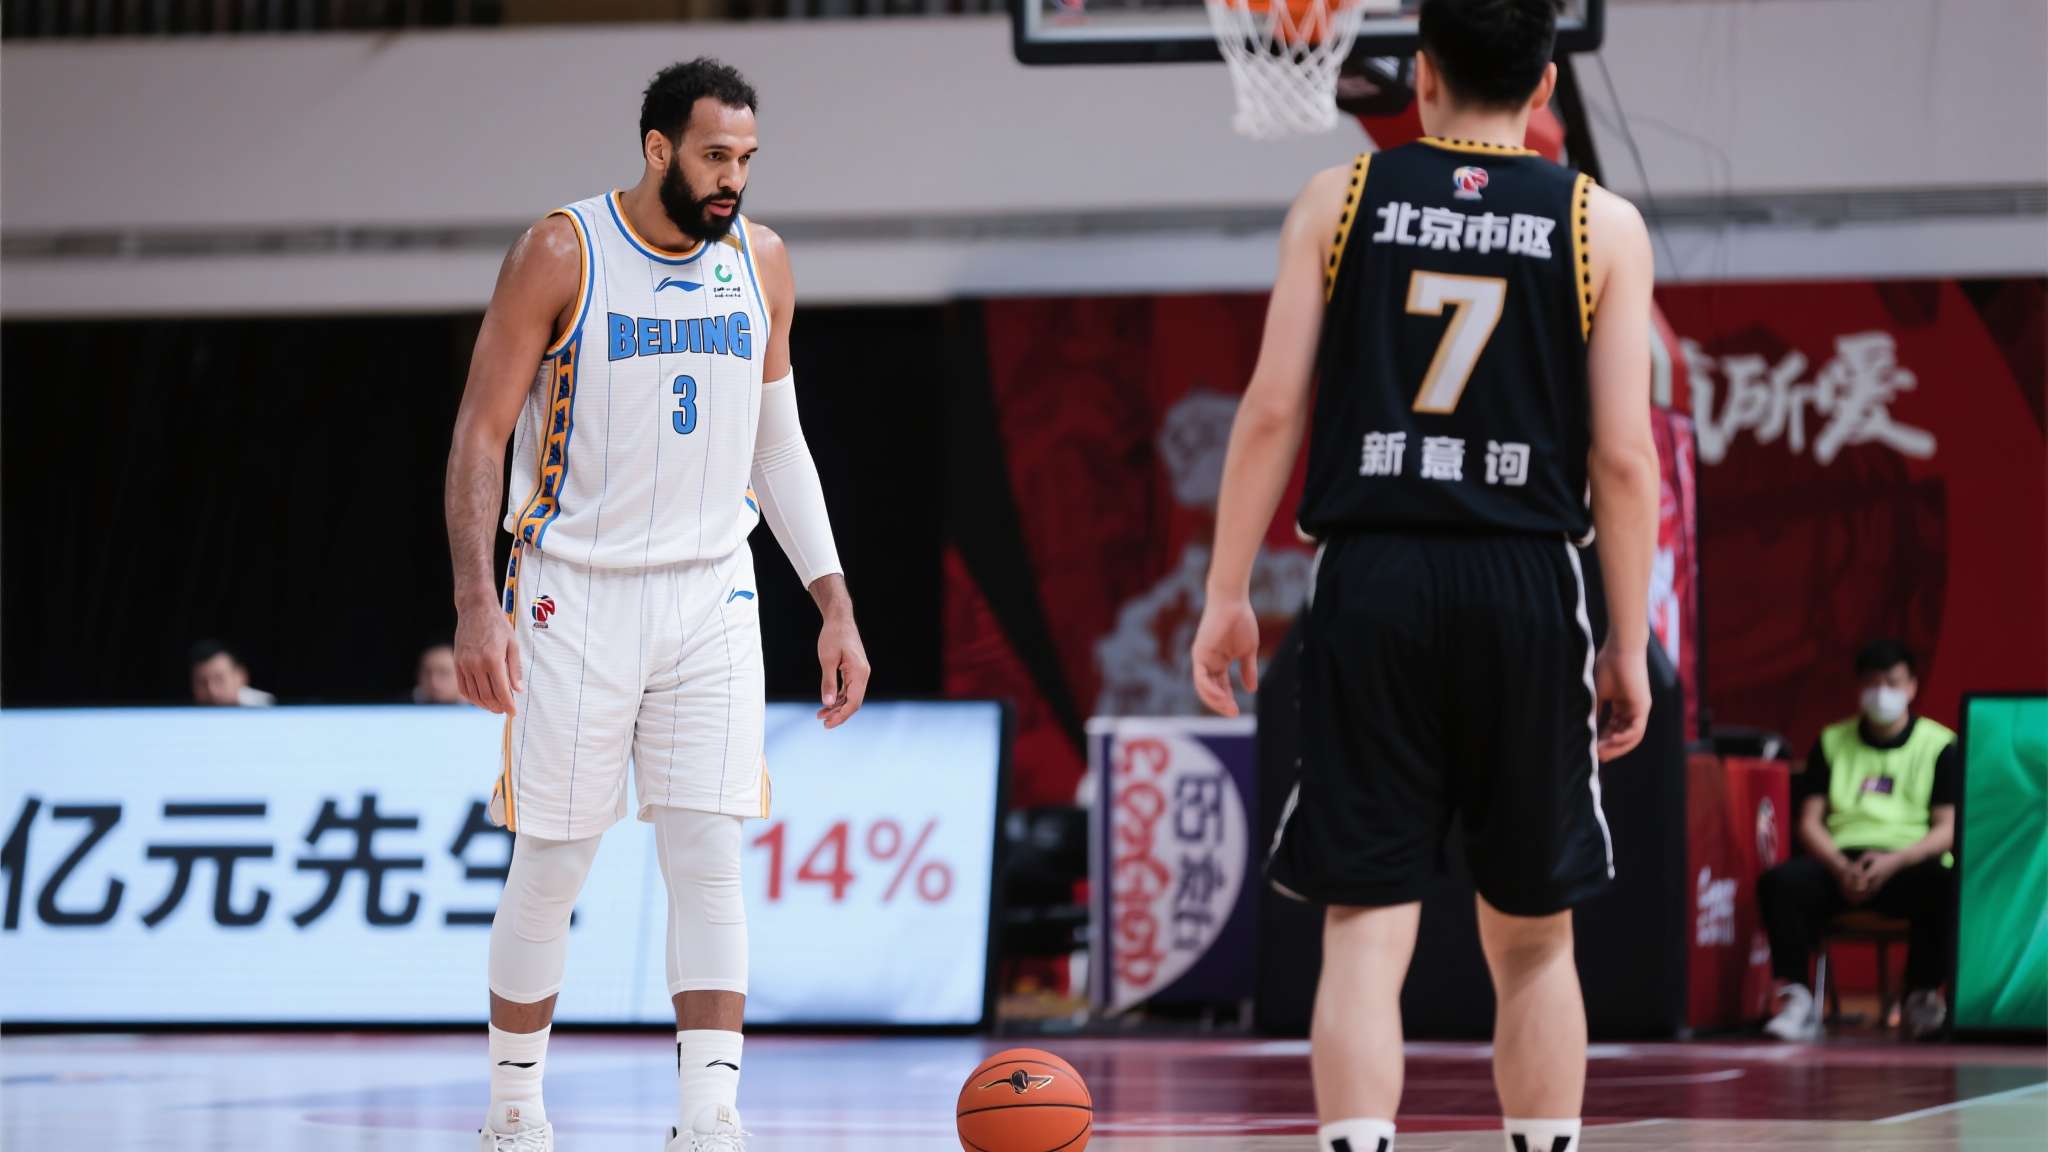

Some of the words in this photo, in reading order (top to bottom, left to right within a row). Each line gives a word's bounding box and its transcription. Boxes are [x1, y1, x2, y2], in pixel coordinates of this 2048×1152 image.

[607, 311, 752, 362] BEIJING
[1405, 269, 1508, 415] 7
[672, 374, 698, 435] 3
[752, 818, 955, 904] 14%
